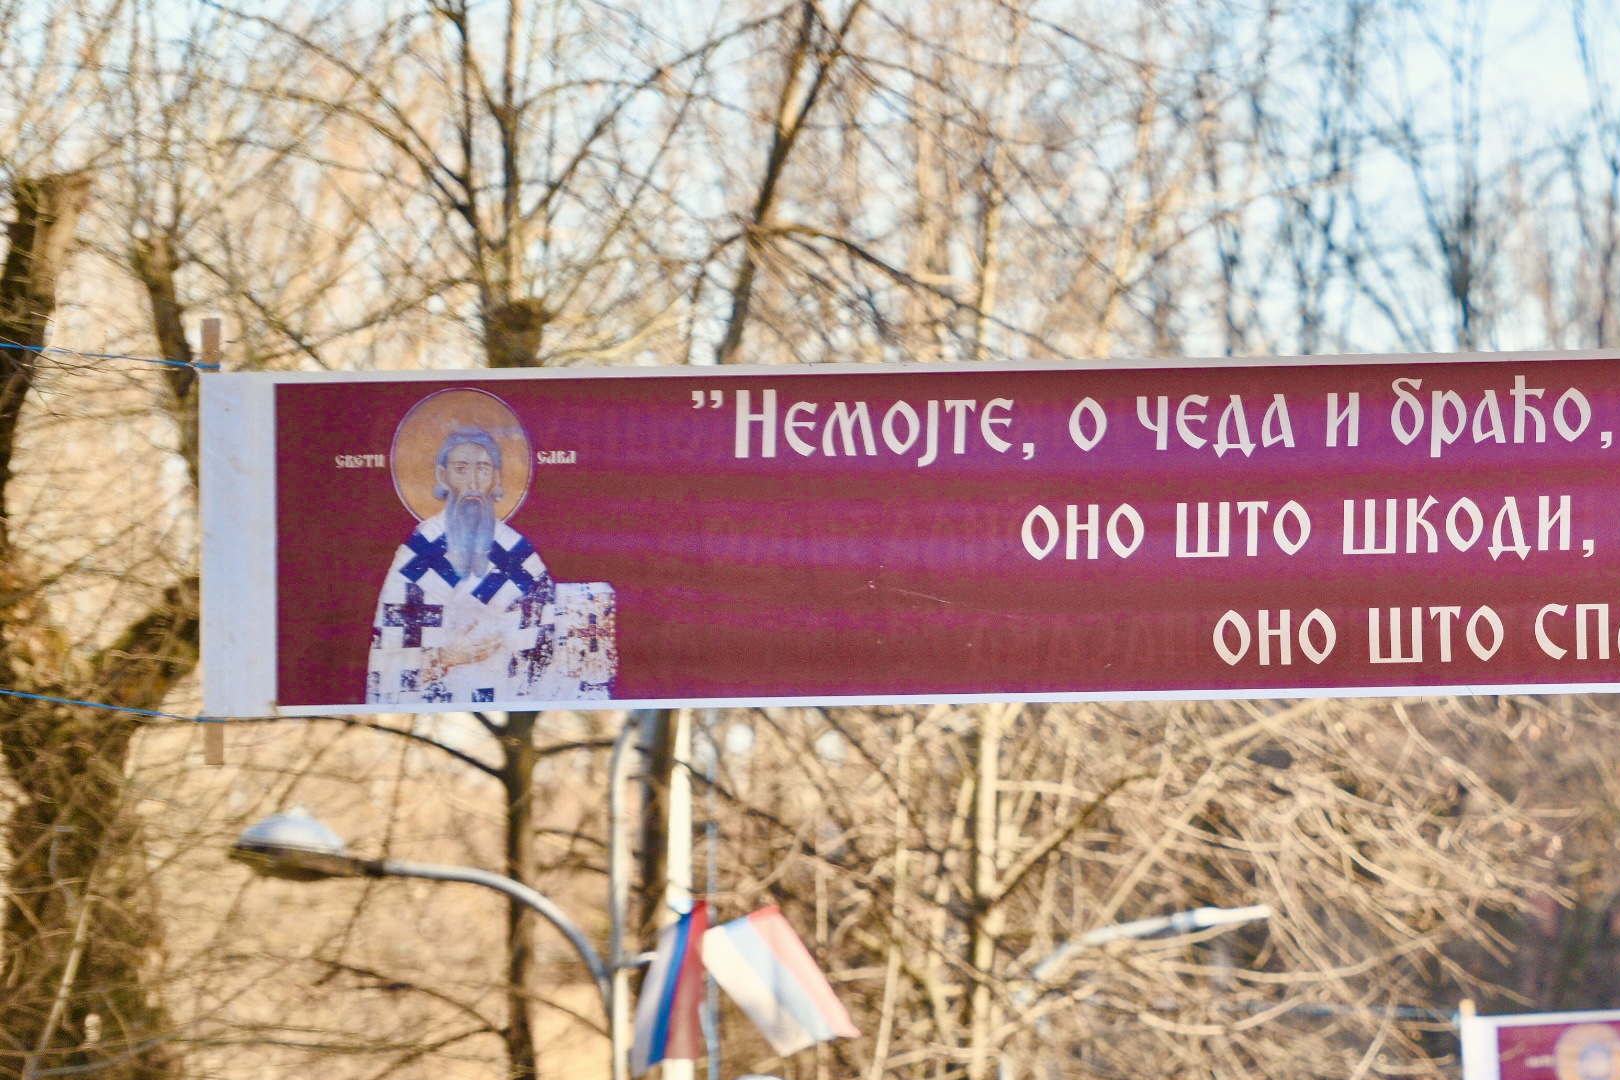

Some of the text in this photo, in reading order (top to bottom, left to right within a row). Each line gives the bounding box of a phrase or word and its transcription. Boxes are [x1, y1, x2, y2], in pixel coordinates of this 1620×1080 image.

[1136, 393, 1295, 458] чеда
[1326, 392, 1360, 447] и
[1391, 375, 1613, 458] браћо,
[1021, 503, 1145, 561] оно
[1175, 499, 1312, 558] што
[1342, 494, 1595, 561] шкоди,
[1212, 608, 1337, 666] оно
[1368, 604, 1505, 664] што
